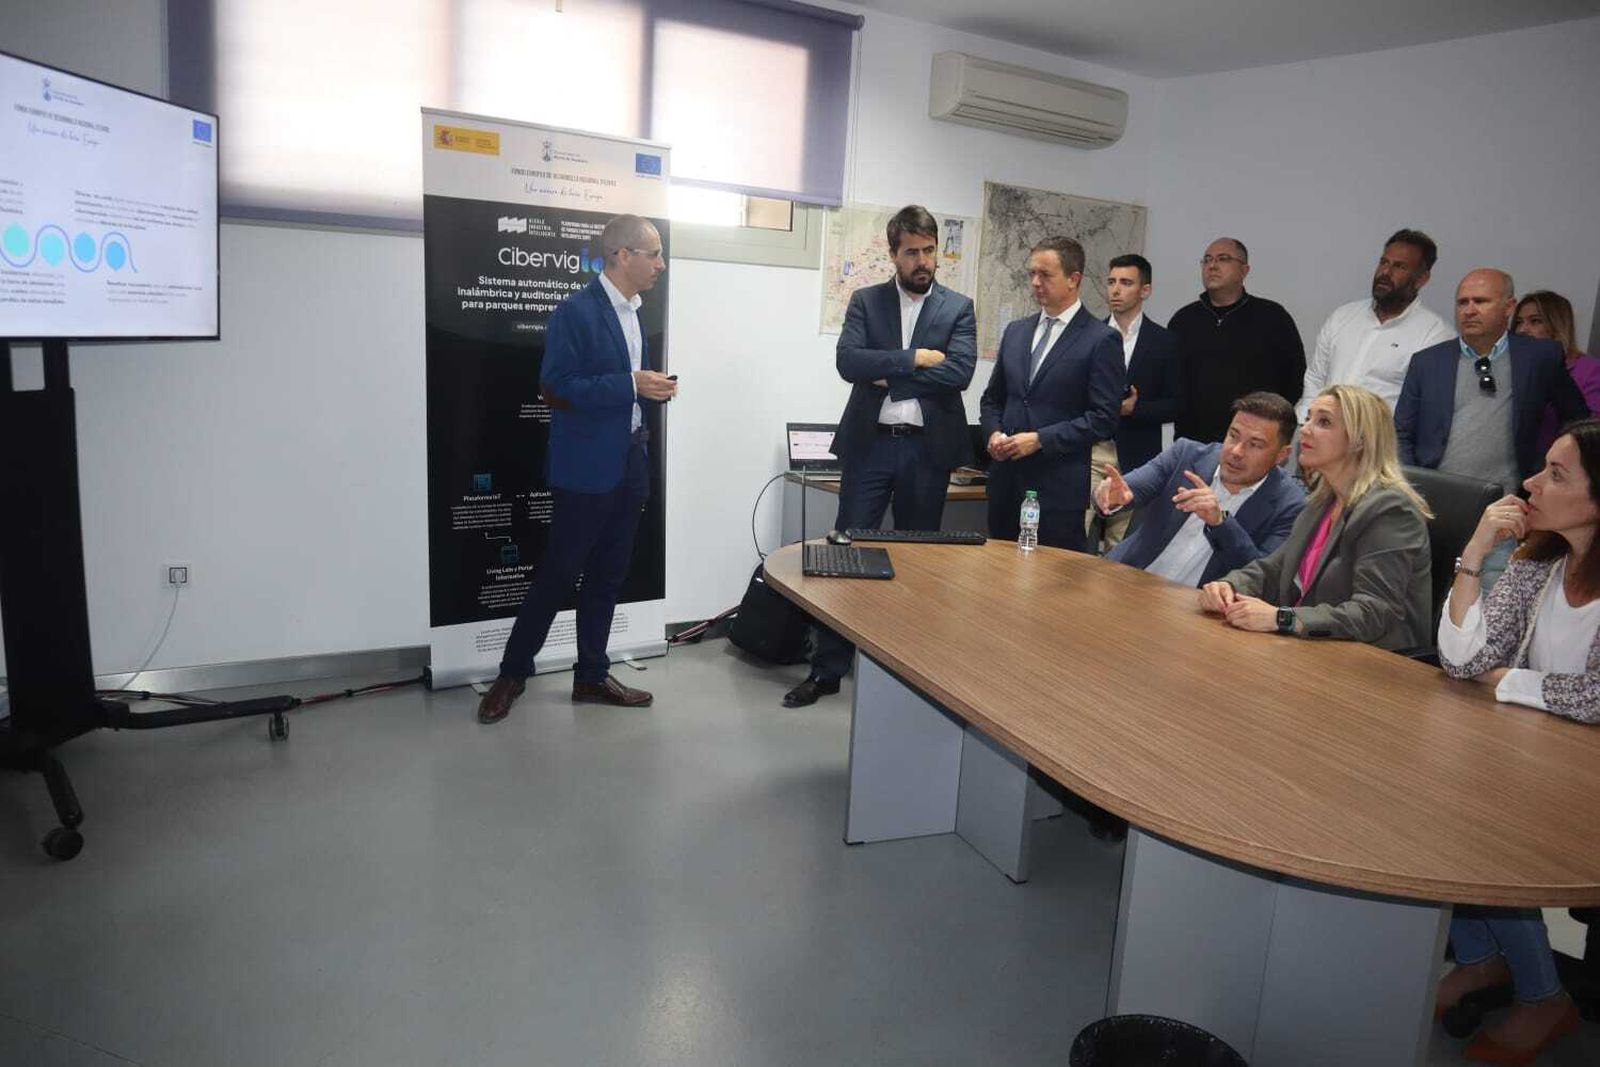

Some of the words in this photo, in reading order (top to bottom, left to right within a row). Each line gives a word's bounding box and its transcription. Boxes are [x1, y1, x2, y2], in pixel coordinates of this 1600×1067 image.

[478, 275, 516, 287] Sistema
[518, 277, 569, 290] automático
[570, 281, 581, 290] de
[514, 291, 520, 301] y
[521, 290, 562, 301] auditoría
[462, 300, 484, 311] para
[485, 301, 523, 312] parques
